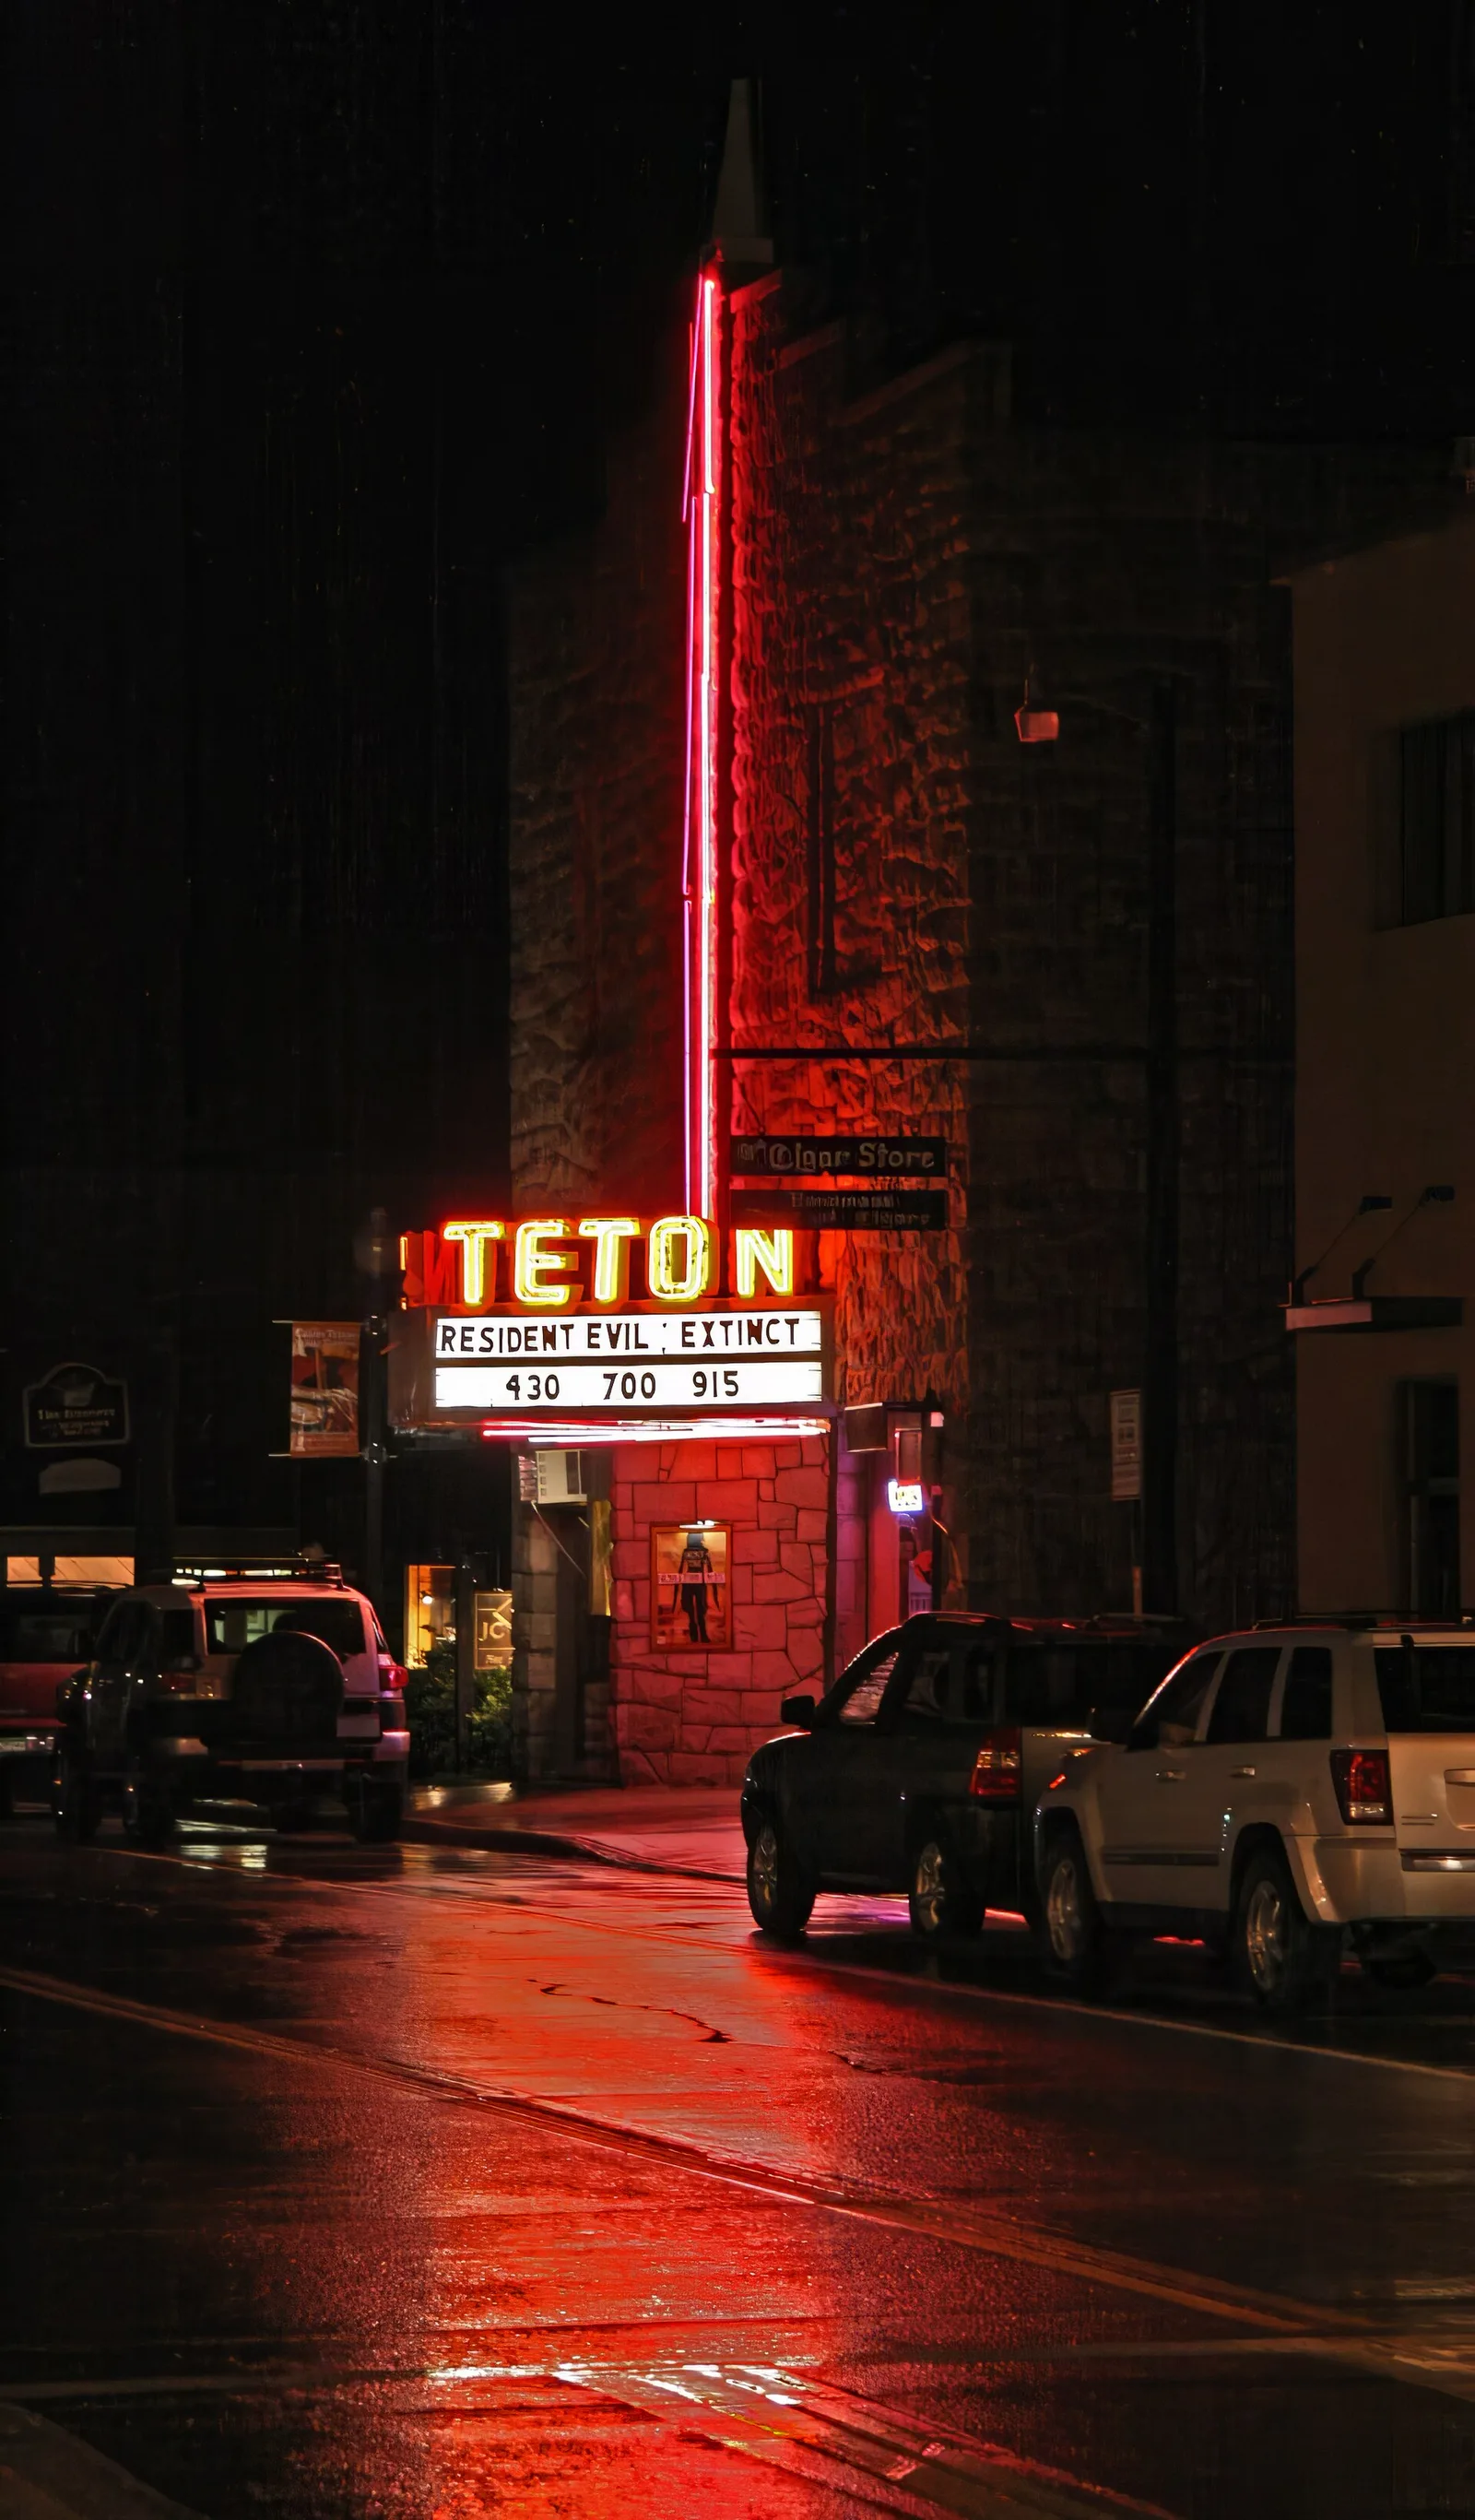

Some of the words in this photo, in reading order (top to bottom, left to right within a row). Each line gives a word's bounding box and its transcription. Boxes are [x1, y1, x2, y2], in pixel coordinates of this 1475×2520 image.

[857, 1142, 936, 1169] Store
[443, 1215, 794, 1307] TETON
[441, 1324, 574, 1354] RESIDENT
[586, 1322, 649, 1351] EVIL
[681, 1318, 800, 1348] EXTINCT
[505, 1374, 560, 1401] 430
[602, 1371, 656, 1401] 700
[692, 1370, 739, 1398] 915
